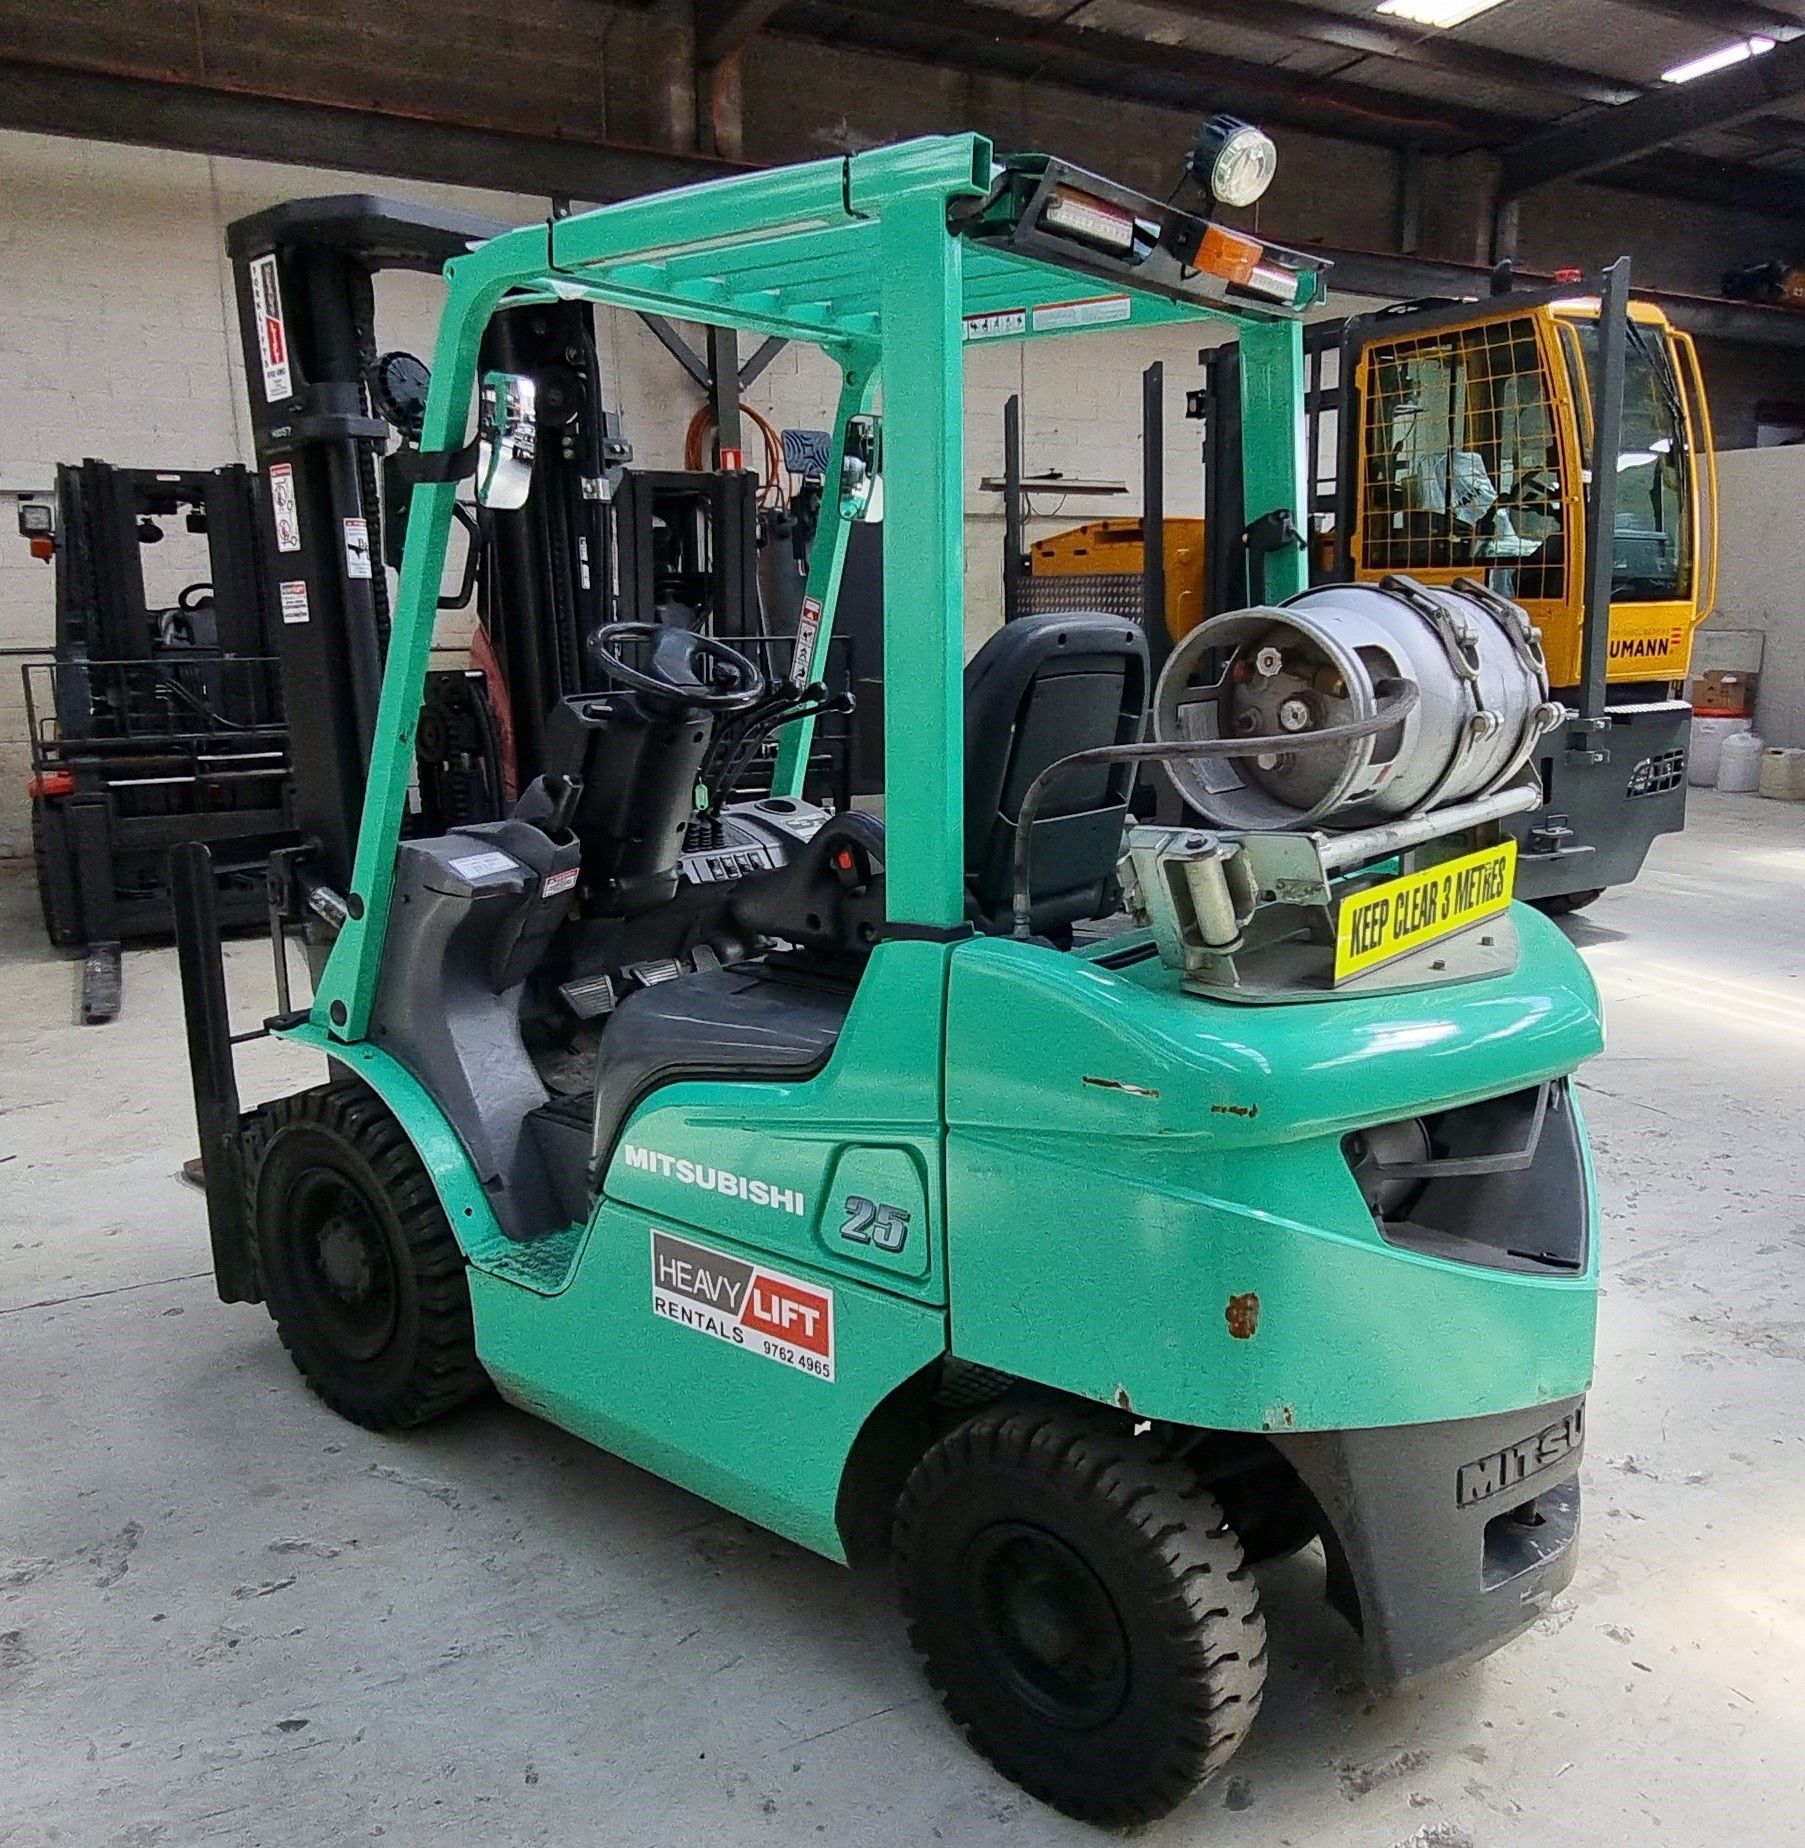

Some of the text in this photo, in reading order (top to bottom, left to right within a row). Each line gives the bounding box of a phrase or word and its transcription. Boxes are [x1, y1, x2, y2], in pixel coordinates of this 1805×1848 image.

[1350, 856, 1507, 958] KEEP CLEAR 3 METRES
[624, 1144, 805, 1217] MITSUBISHI
[839, 1195, 912, 1252] 25
[655, 1296, 831, 1379] RENTALS 9762 4965
[659, 1253, 820, 1338] HEAVY LIFT
[1457, 1401, 1586, 1511] MITSU
